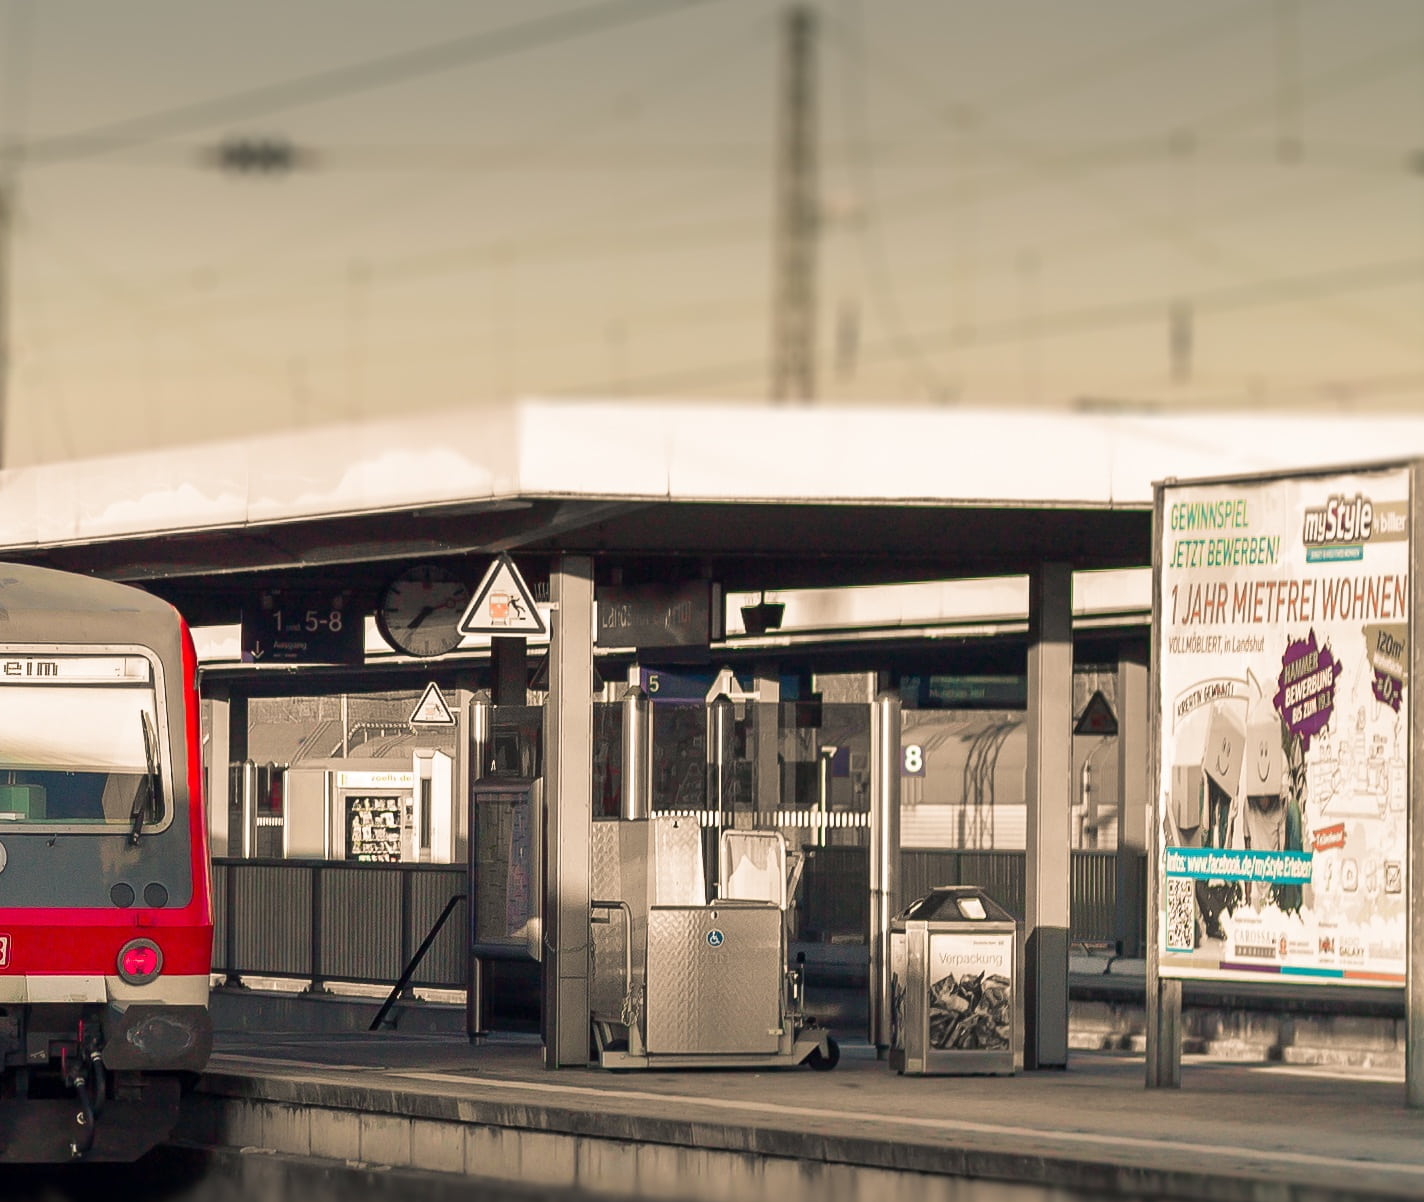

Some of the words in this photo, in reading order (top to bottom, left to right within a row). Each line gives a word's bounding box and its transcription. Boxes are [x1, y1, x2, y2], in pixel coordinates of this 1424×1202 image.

[1171, 499, 1250, 531] GEWINNSPIEL
[1303, 496, 1372, 544] myStyle
[1169, 539, 1205, 568] JETZT
[1207, 535, 1280, 567] BEWERBEN!
[1172, 583, 1179, 625] 1
[1182, 581, 1228, 625] JAHR
[1232, 578, 1318, 624] MIETFREI
[1322, 574, 1408, 621] WOHNEN
[273, 610, 283, 631] 1
[305, 610, 343, 632] 5-8
[1169, 632, 1223, 655] VOLLMÖBLIERT,
[1224, 635, 1231, 653] in
[1232, 633, 1265, 653] Landshut
[649, 675, 660, 692] 5
[1284, 651, 1319, 685] HAMMER
[1285, 665, 1333, 708] BEWERBUNG
[1303, 696, 1317, 720] ZUM
[904, 744, 923, 774] 8
[939, 951, 1004, 967] Verpackung
